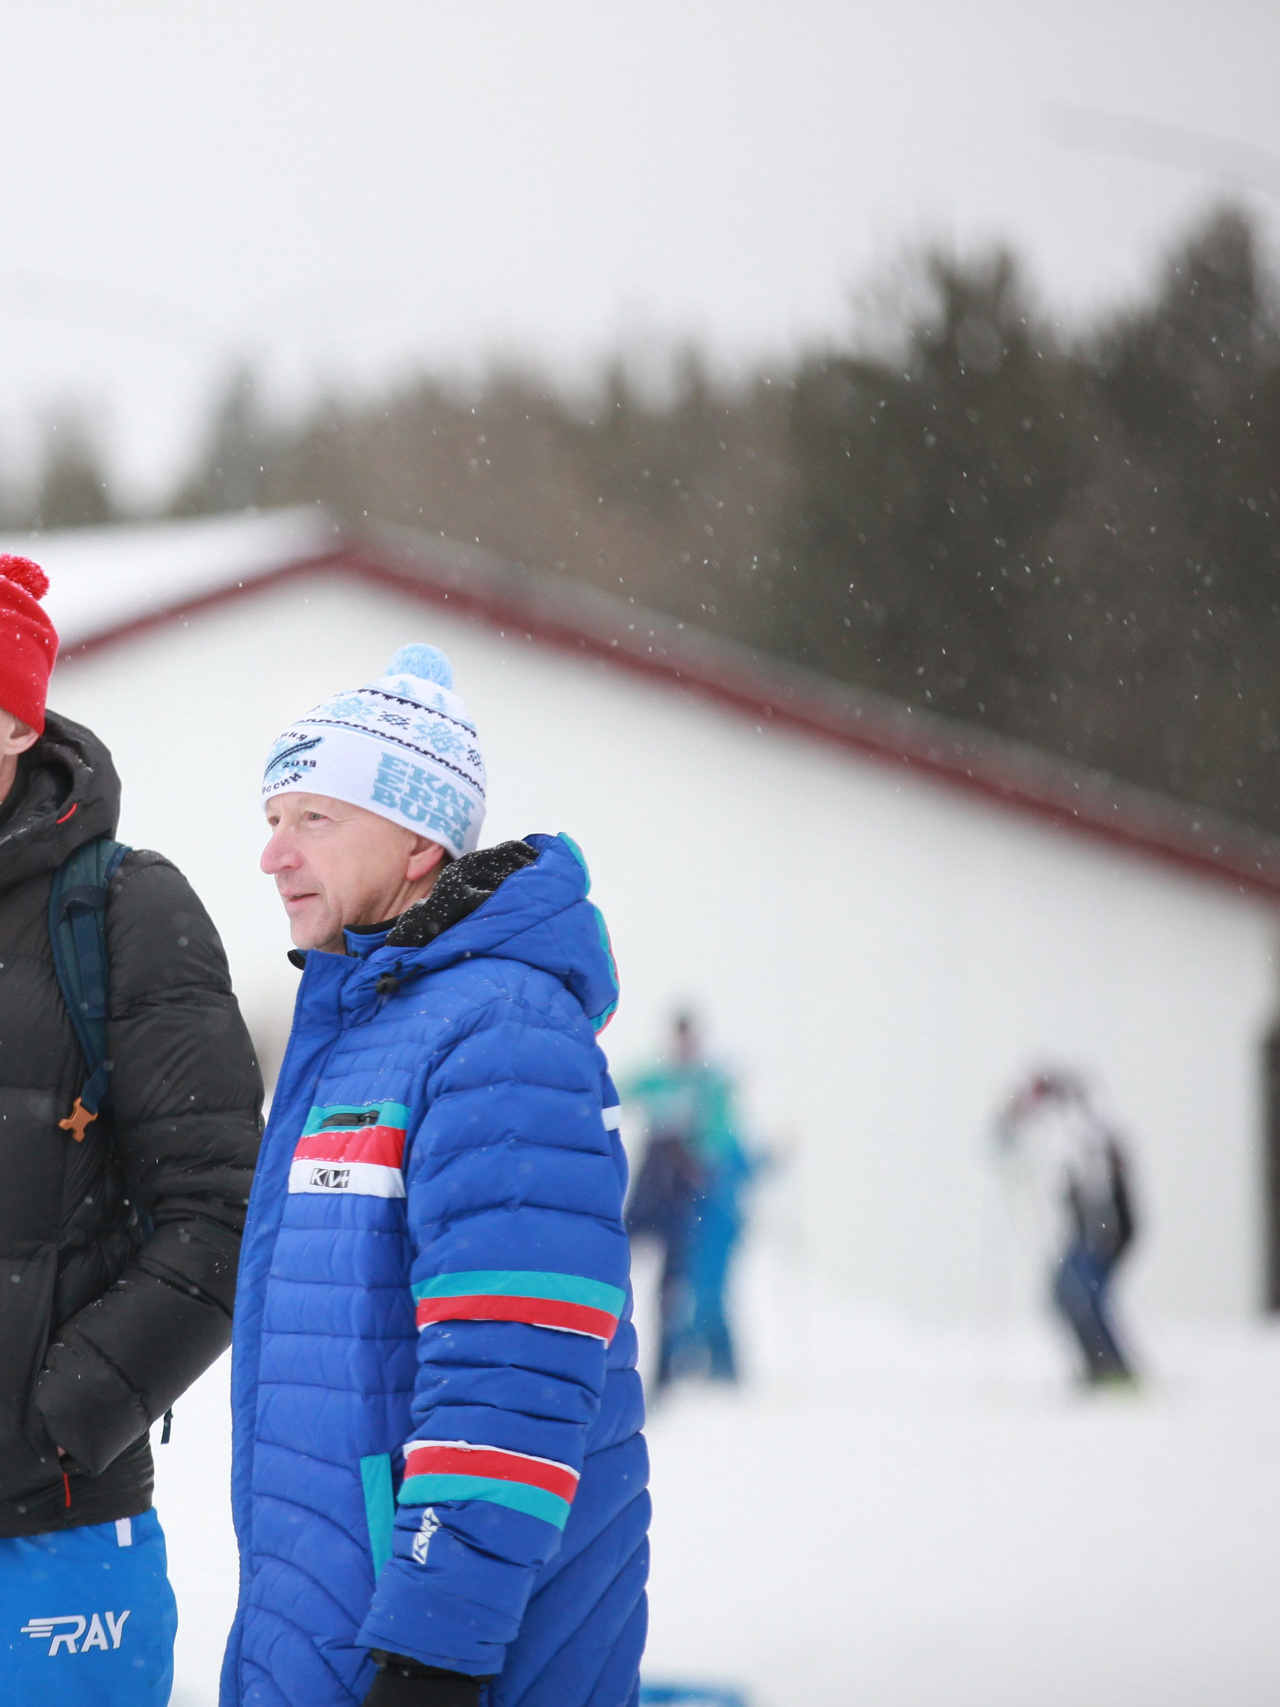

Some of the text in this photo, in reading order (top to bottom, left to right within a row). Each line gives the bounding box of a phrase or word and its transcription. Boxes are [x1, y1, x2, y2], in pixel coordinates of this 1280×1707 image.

[370, 783, 465, 850] BURG
[375, 766, 471, 833] ERIN
[379, 751, 475, 818] EKAT
[20, 1610, 131, 1657] RAY
